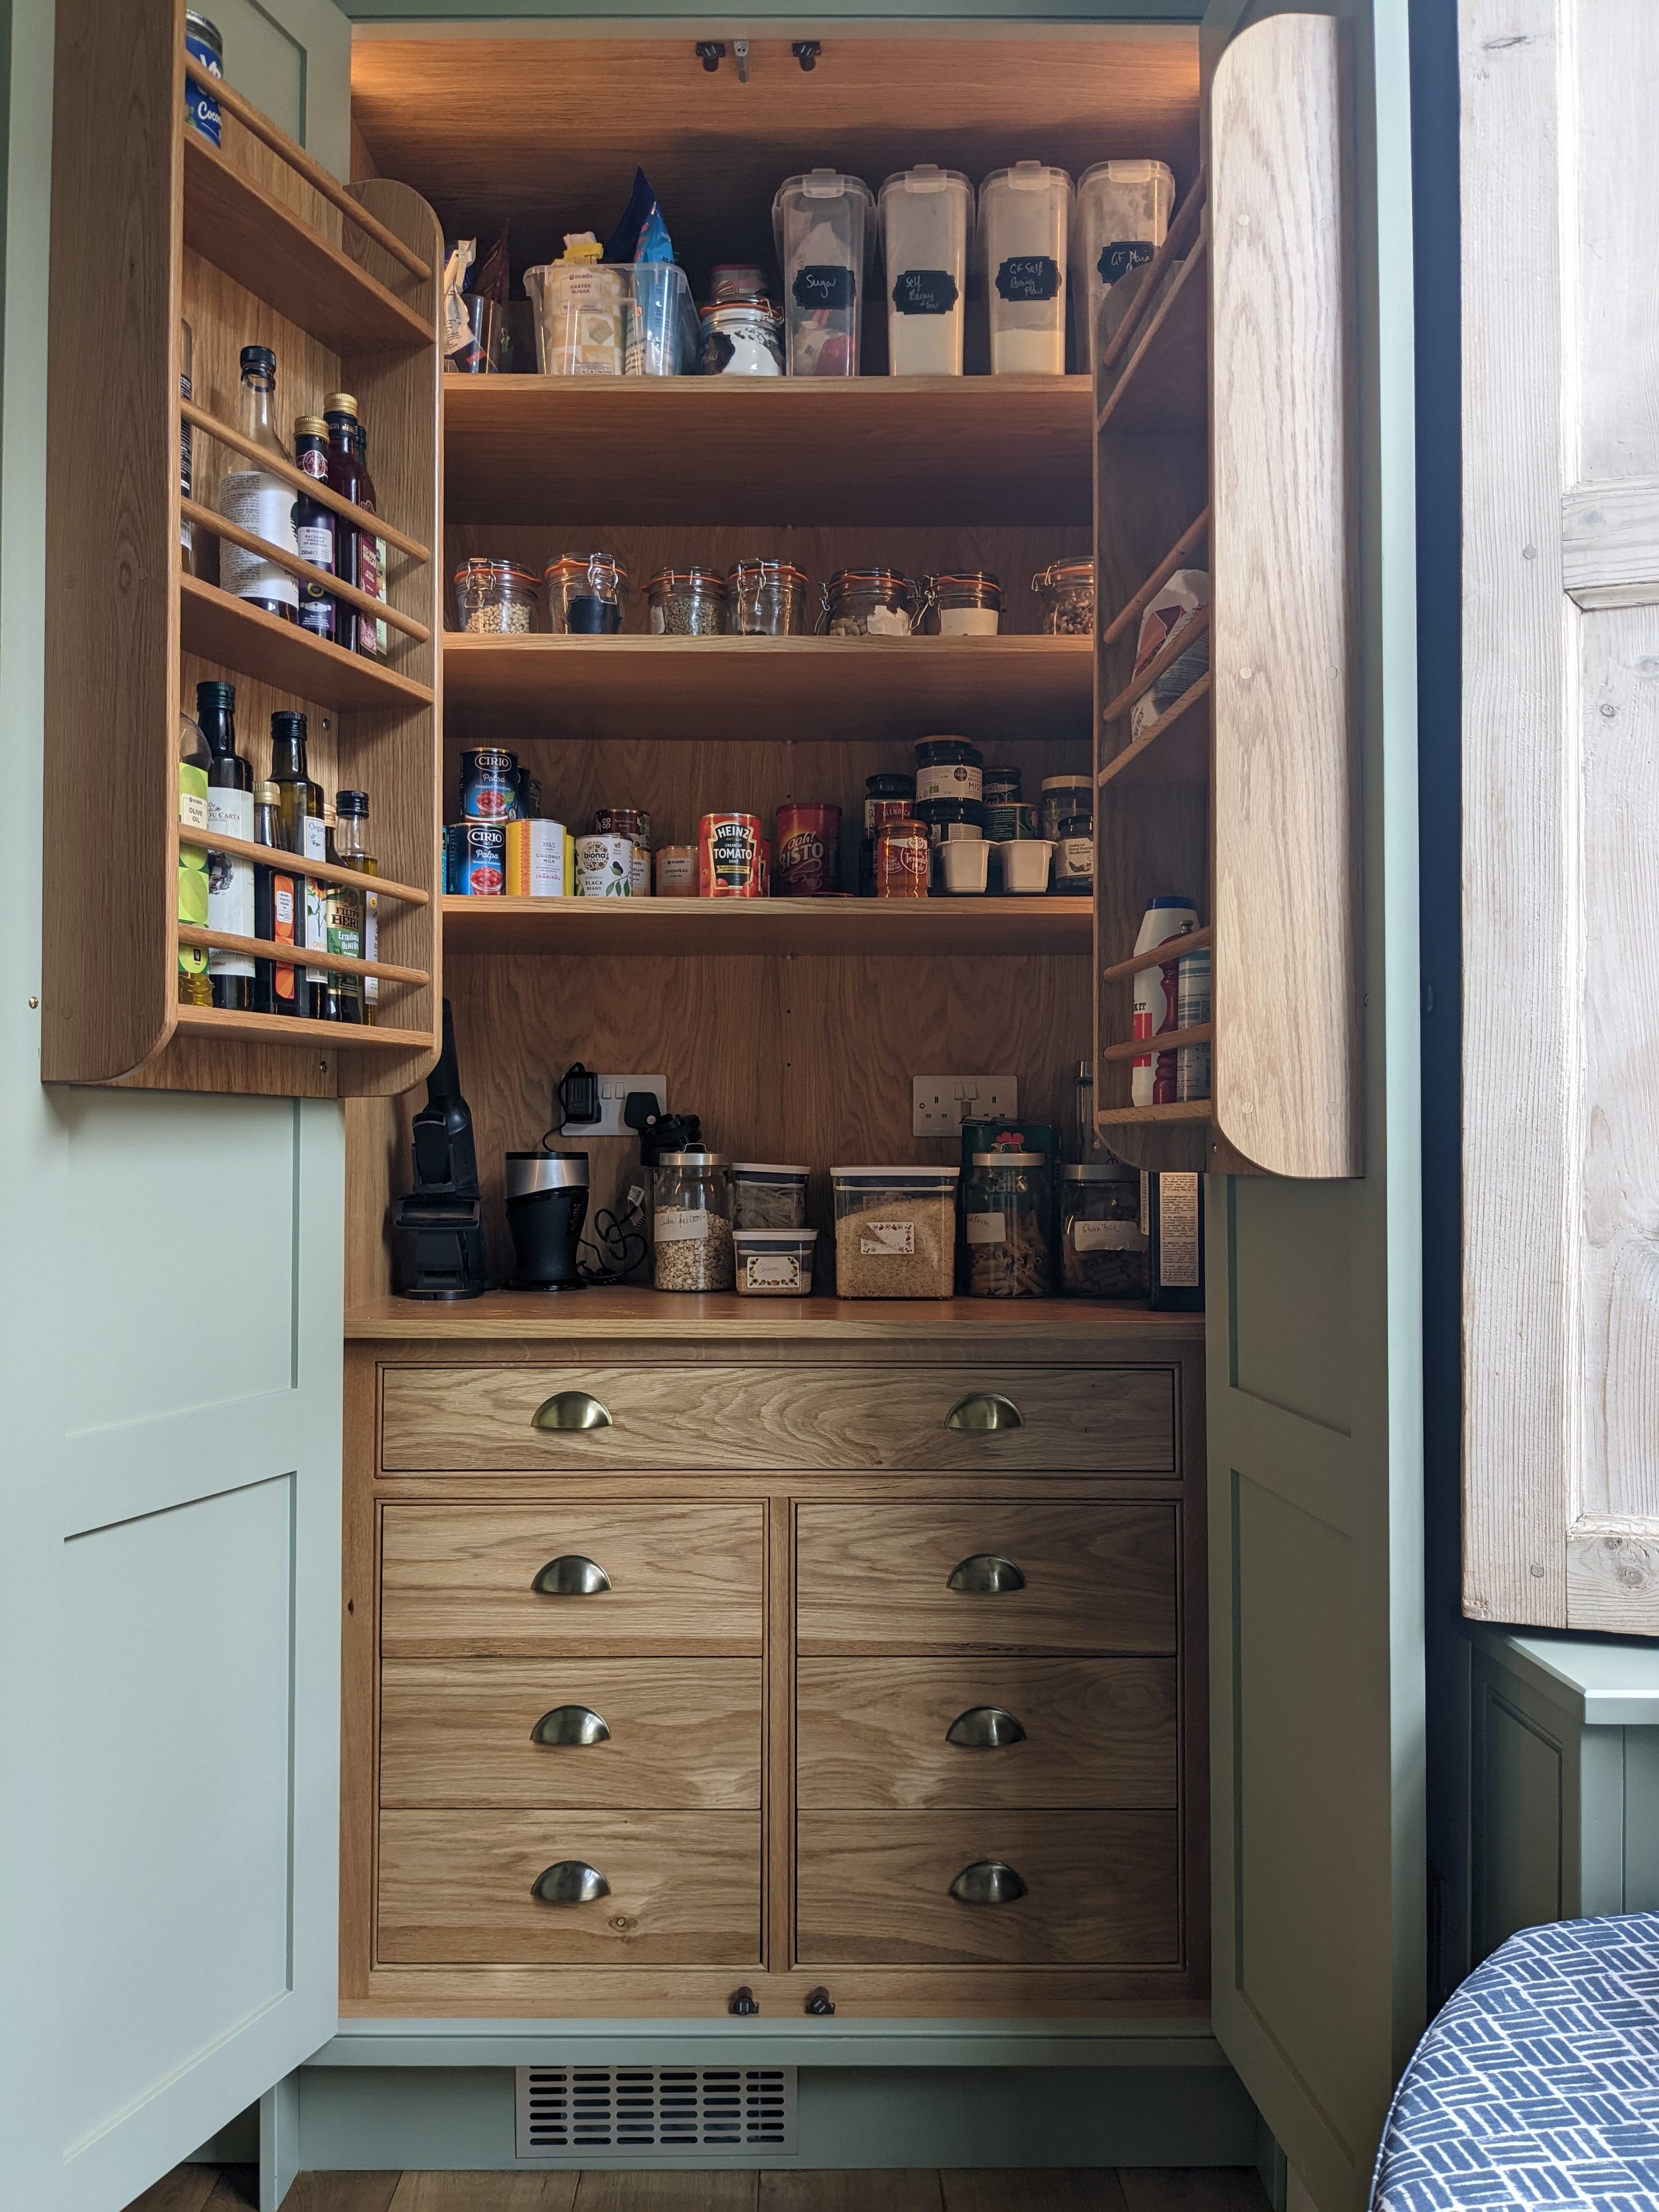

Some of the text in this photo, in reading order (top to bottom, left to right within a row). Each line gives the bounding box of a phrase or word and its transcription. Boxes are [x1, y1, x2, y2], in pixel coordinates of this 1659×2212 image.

[1025, 261, 1044, 276] Self
[806, 274, 836, 298] Sugar
[906, 275, 922, 292] Self
[478, 757, 510, 767] CIRIO
[482, 773, 506, 784] Polpa
[188, 807, 203, 818] OLIVE
[218, 812, 241, 820] CARTA
[470, 831, 503, 844] CIRIO
[717, 826, 750, 840] HEINZ
[476, 849, 500, 861] Polpa
[713, 848, 753, 859] TOMATO
[779, 842, 824, 875] BISTO
[331, 913, 359, 930] BERI
[342, 941, 354, 950] OLIVE
